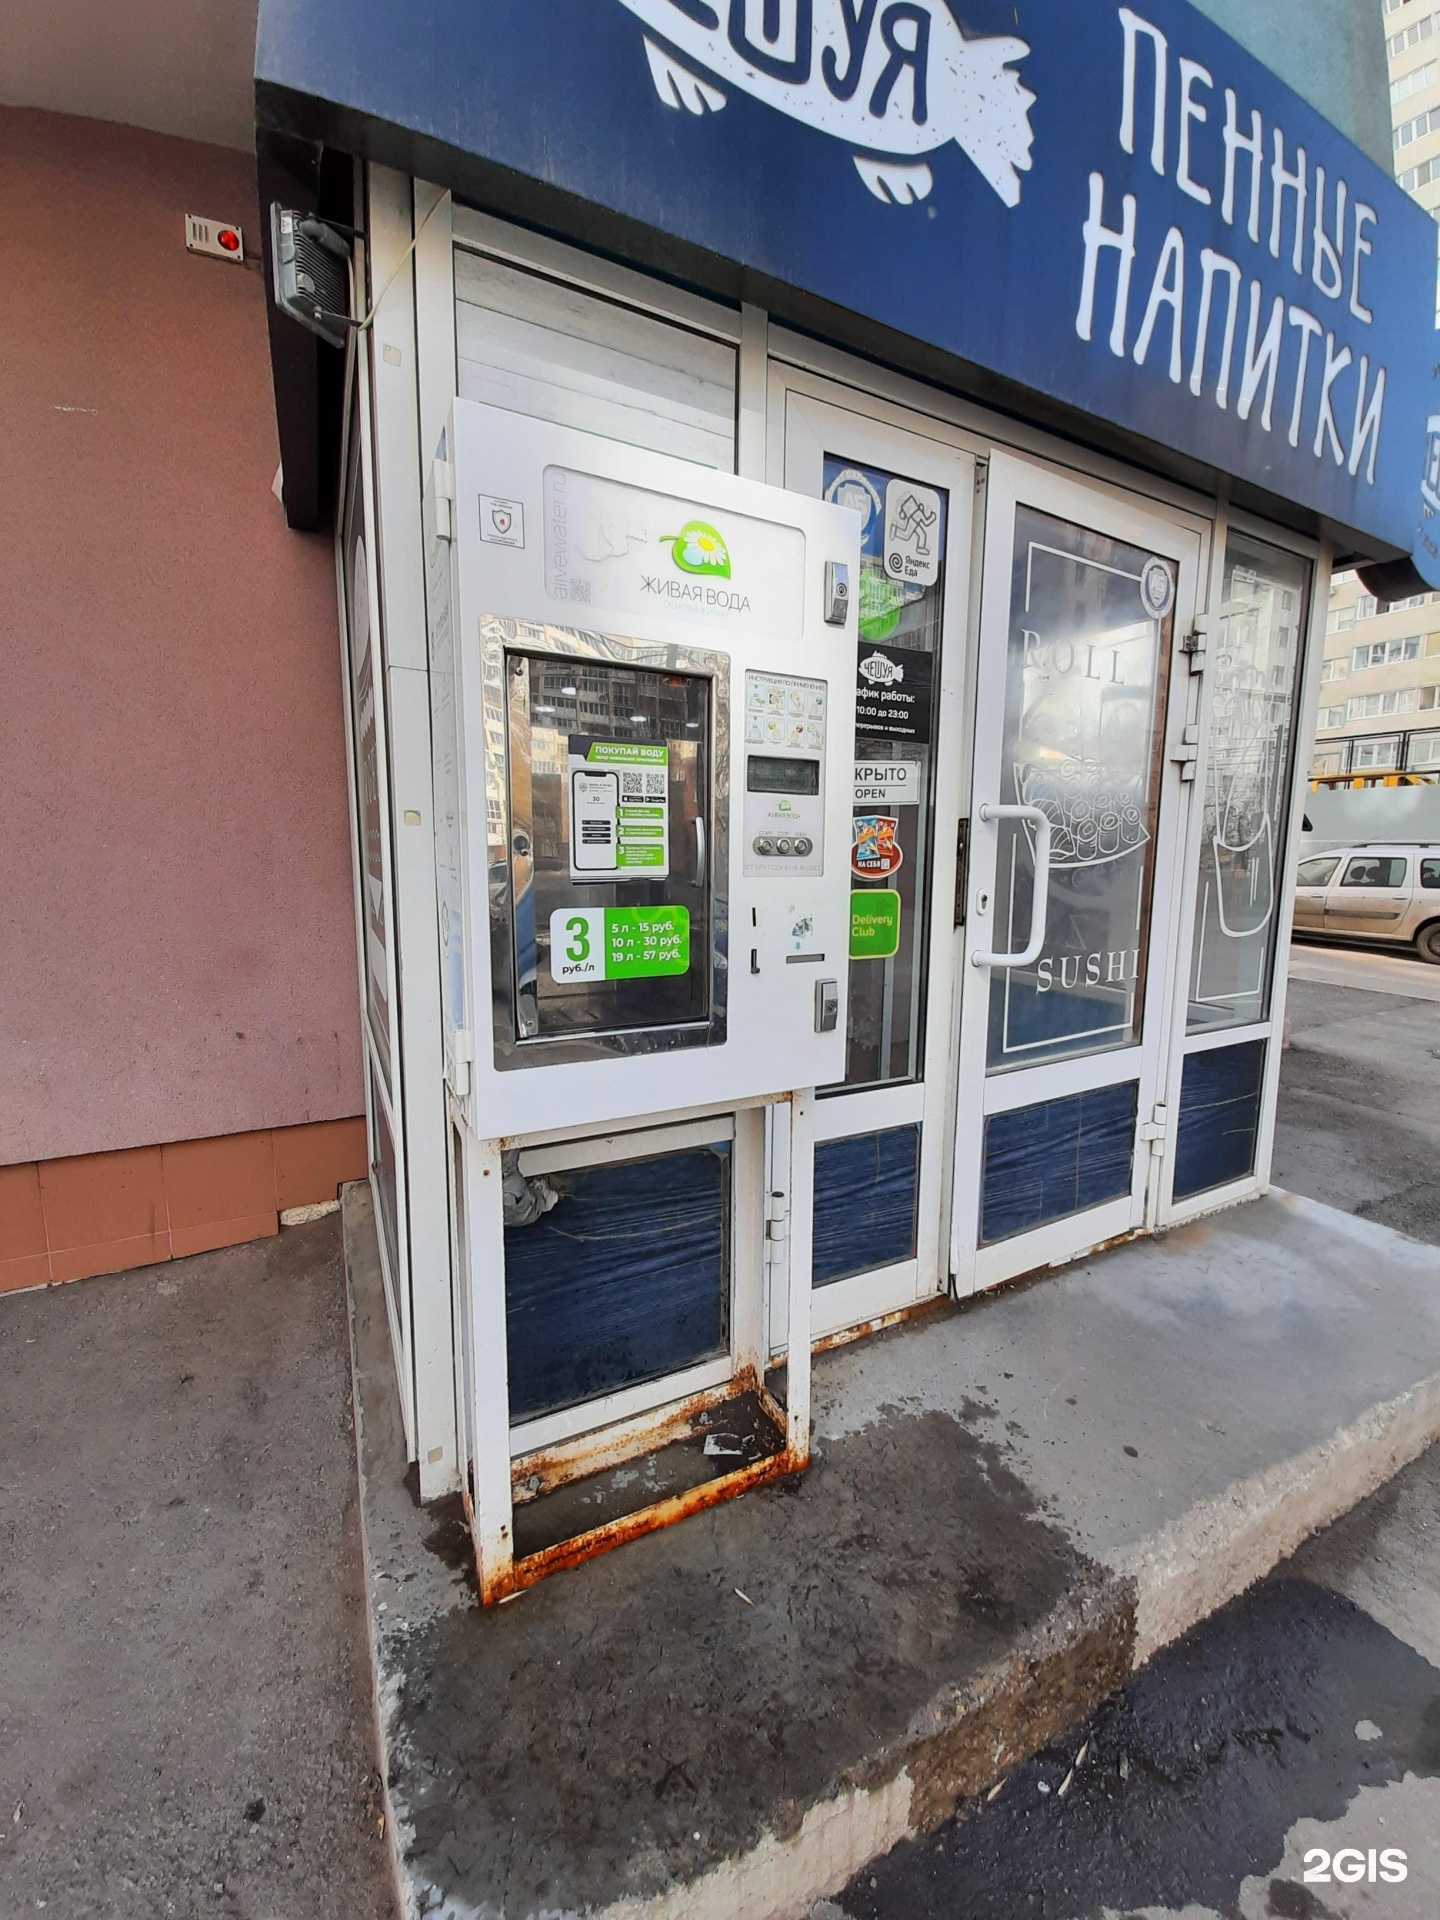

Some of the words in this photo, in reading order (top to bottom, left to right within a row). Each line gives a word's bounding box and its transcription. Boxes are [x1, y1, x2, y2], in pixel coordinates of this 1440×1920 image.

[667, 0, 931, 126] ШУЯ
[1118, 7, 1378, 325] ПЕННЫЕ
[1075, 171, 1387, 486] НАПИТКИ
[905, 555, 930, 570] Яндекс
[904, 565, 918, 578] Еда
[640, 574, 703, 602] ЖИВАЯ
[706, 588, 751, 613] ВОДА
[1021, 629, 1126, 686] ROLL
[864, 661, 893, 679] ЧЕШУЯ
[856, 687, 879, 700] афик
[881, 691, 916, 703] работы:
[888, 709, 909, 720] 23:00
[595, 746, 639, 756] ПОКУПАЙ
[640, 748, 664, 758] ВОДУ
[854, 768, 907, 781] КРЫТО
[855, 789, 886, 799] OPEN
[612, 923, 619, 933] 5
[621, 924, 629, 932] л
[639, 922, 649, 932] 15
[652, 921, 675, 934] руб.
[852, 914, 892, 928] Delivery
[852, 927, 875, 937] Club
[565, 917, 591, 962] 3
[612, 938, 624, 948] 10
[626, 938, 634, 946] л
[643, 936, 657, 946] 30
[660, 935, 682, 947] руб.
[612, 952, 623, 962] 19
[643, 950, 655, 960] 57
[659, 949, 681, 961] руб.
[562, 962, 595, 975] руб./л
[1036, 949, 1140, 994] SUSHI
